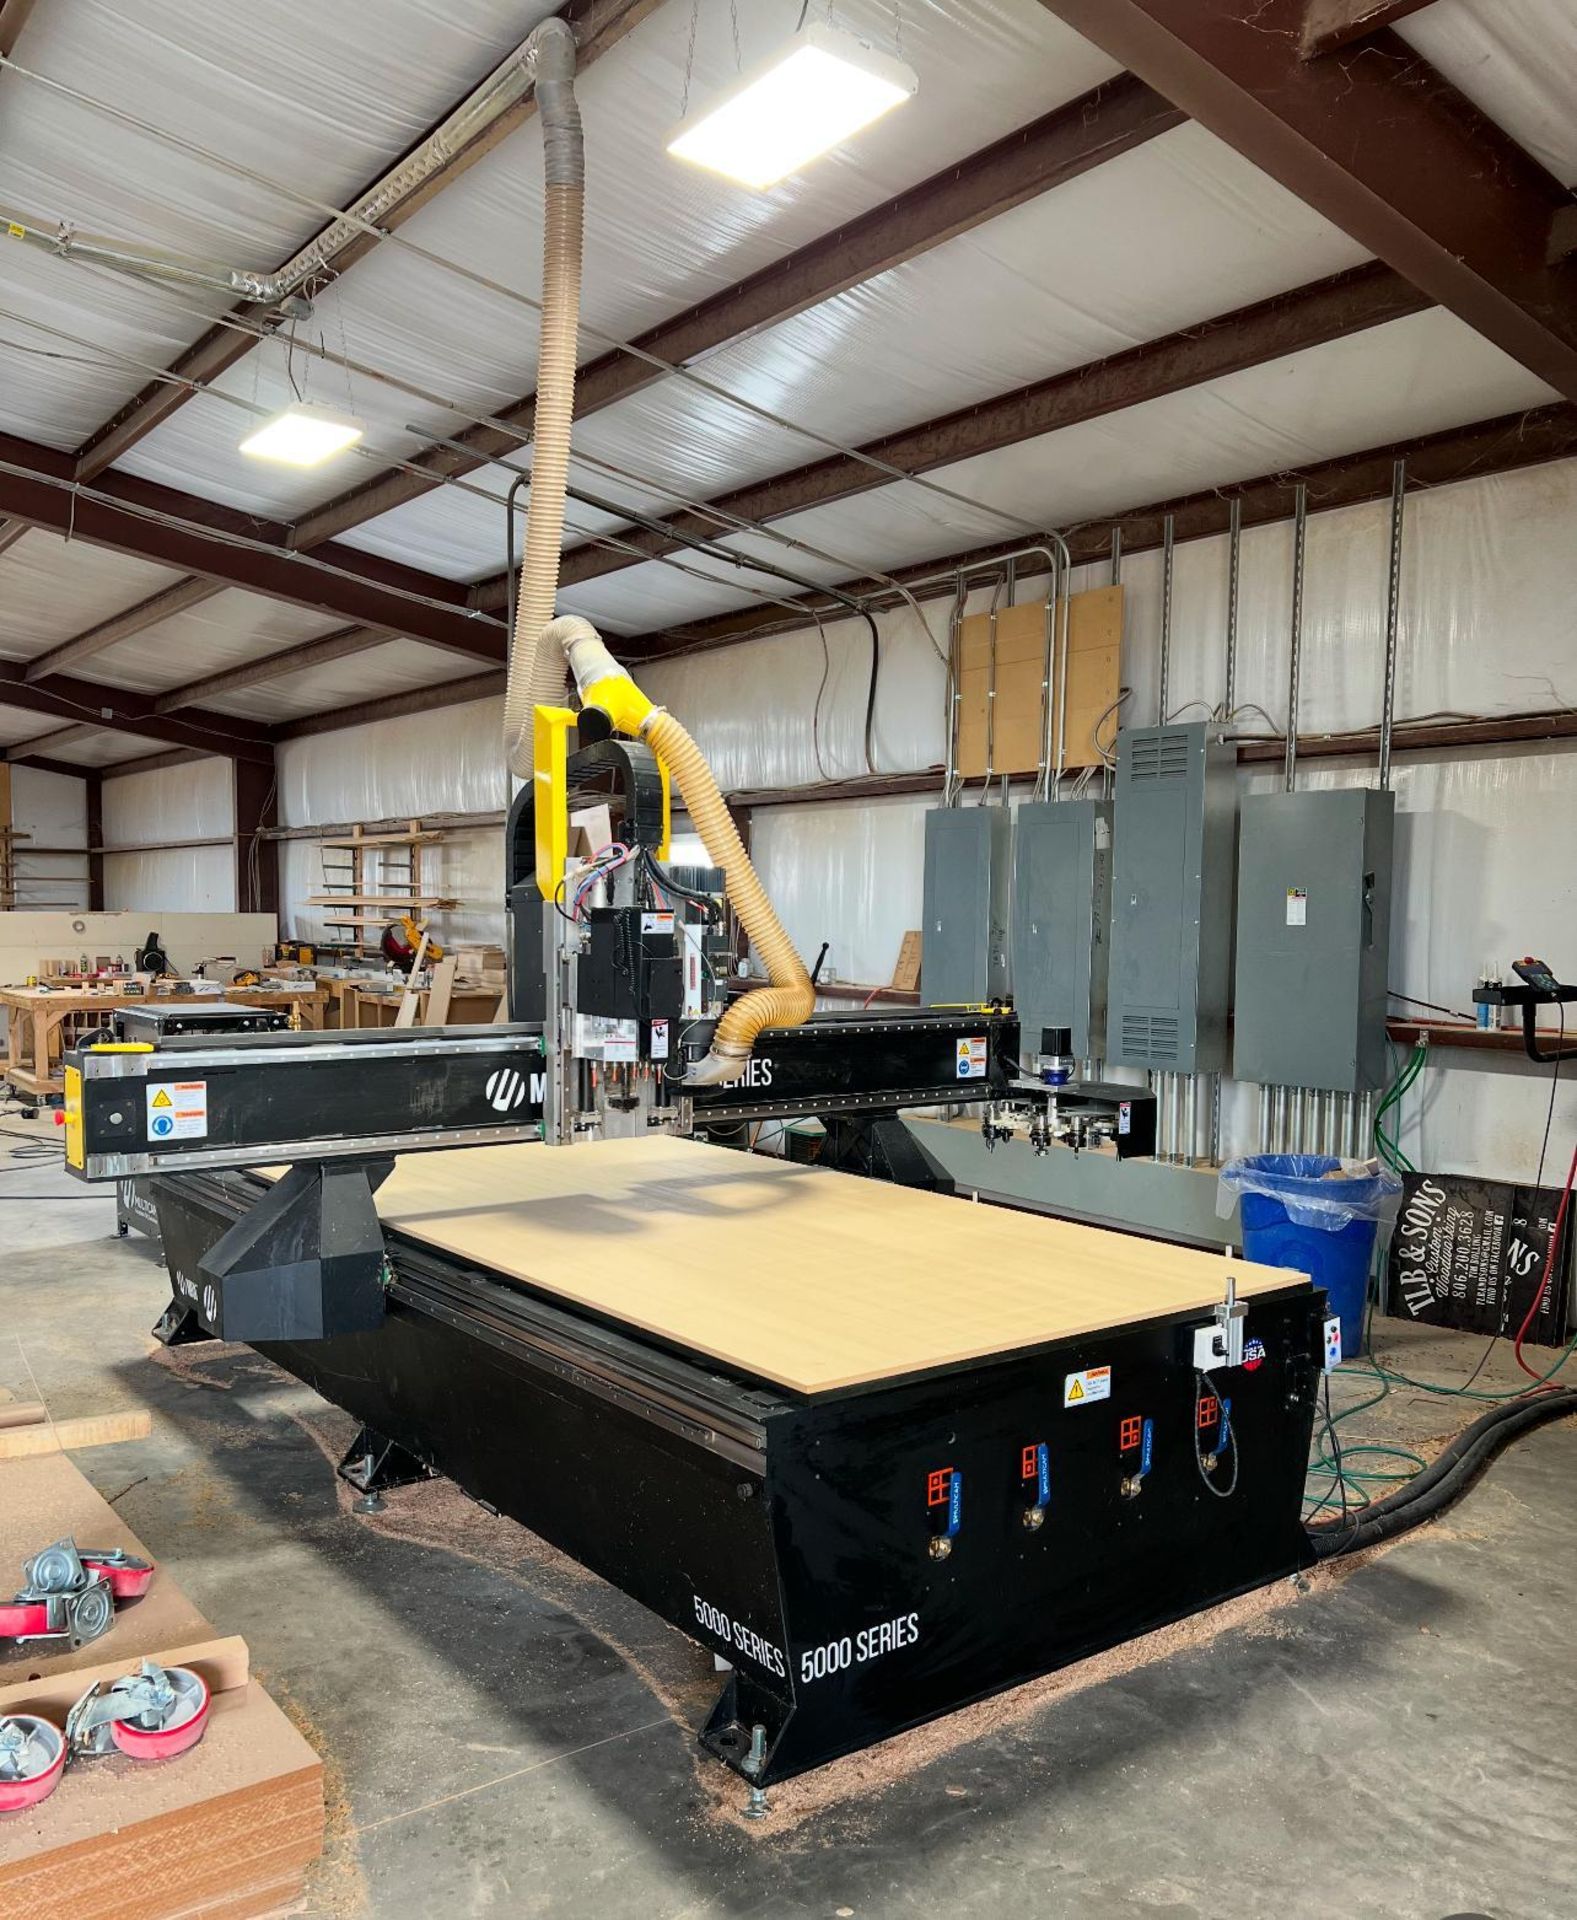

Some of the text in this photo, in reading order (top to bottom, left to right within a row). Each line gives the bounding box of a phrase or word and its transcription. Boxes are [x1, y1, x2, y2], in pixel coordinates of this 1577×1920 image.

[719, 1058, 773, 1089] IES
[1398, 1179, 1446, 1316] TLB & SONS
[1426, 1226, 1442, 1274] Custom
[1436, 1206, 1460, 1298] Woodworking
[1453, 1210, 1475, 1299] 806.200.3628
[1507, 1238, 1540, 1276] NS
[693, 1594, 786, 1678] 5000 SERIES
[801, 1612, 920, 1683] 5000 SERIES
